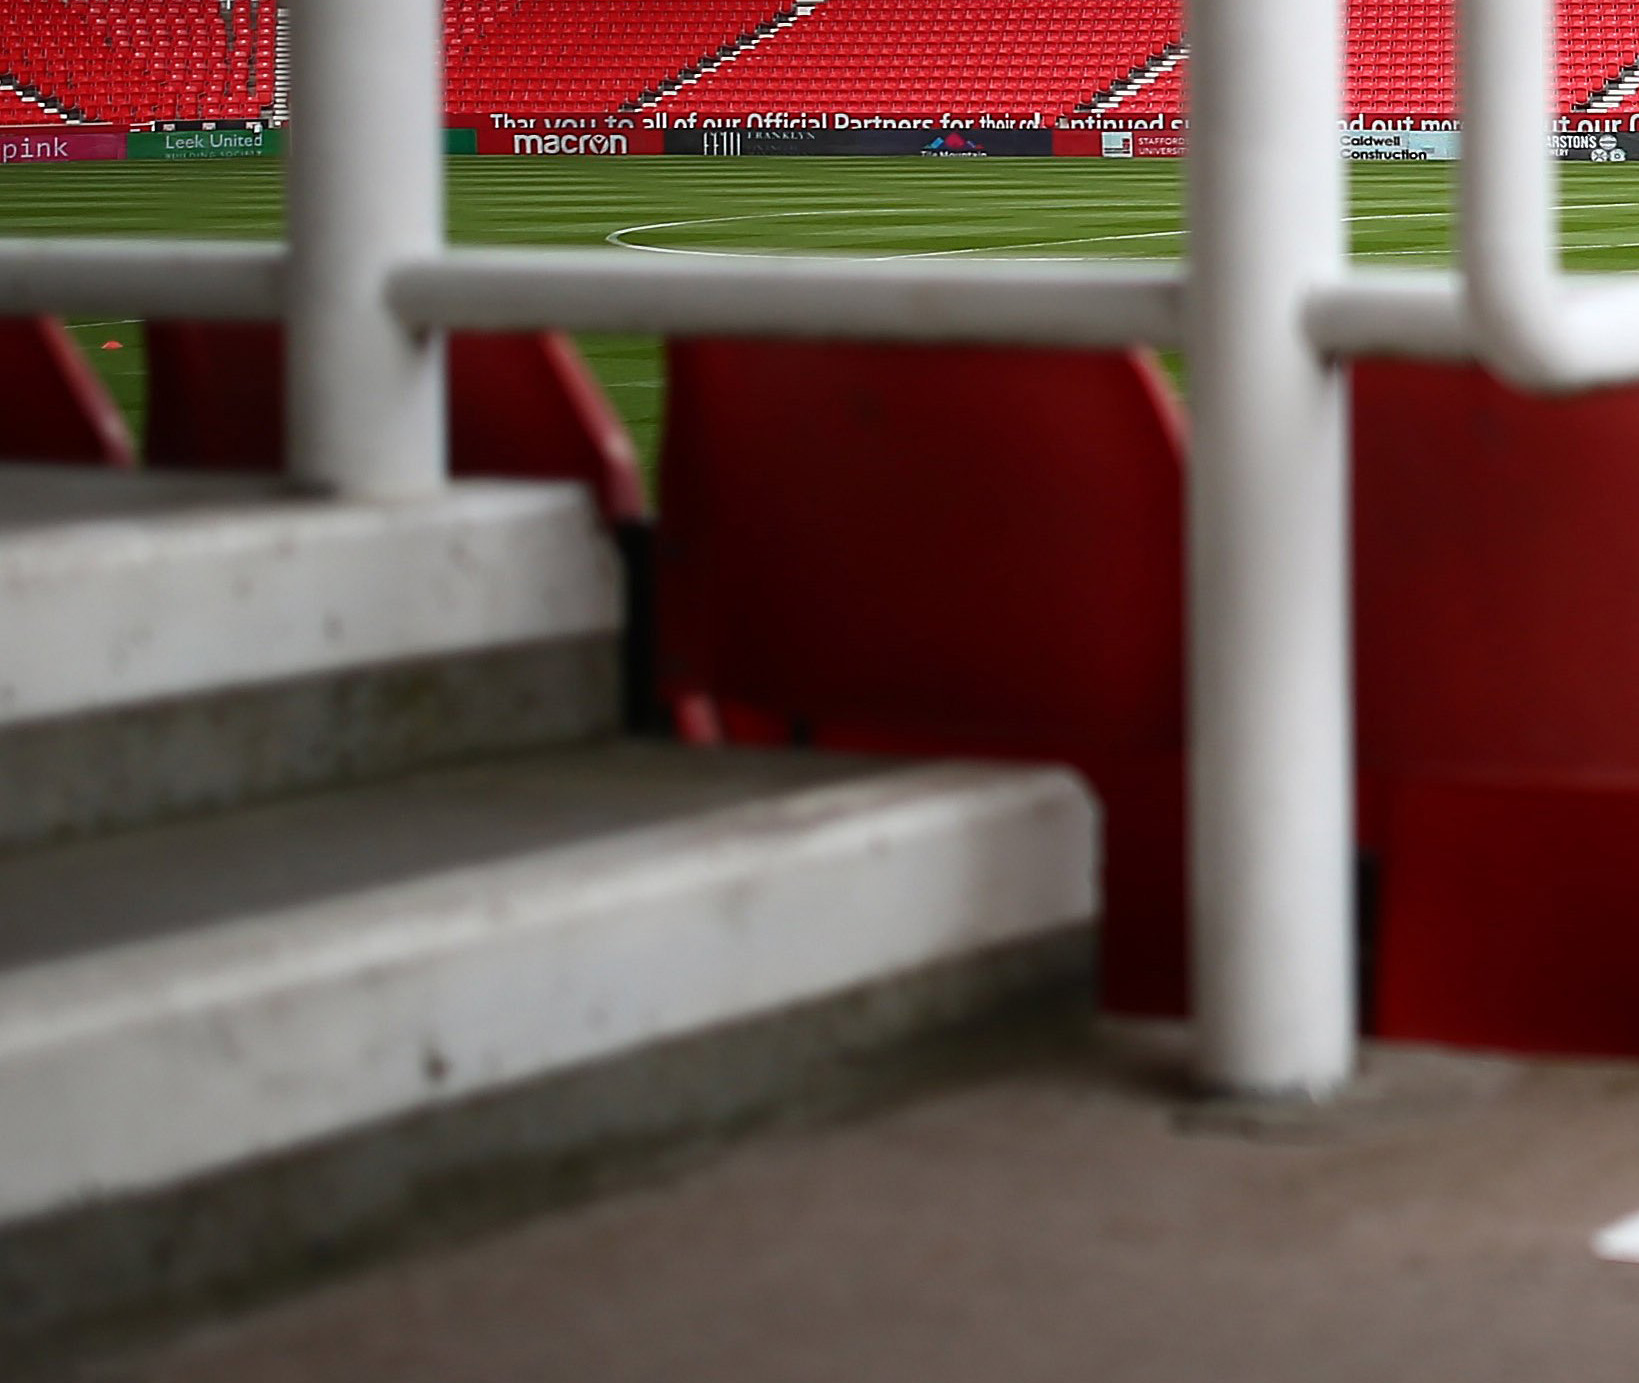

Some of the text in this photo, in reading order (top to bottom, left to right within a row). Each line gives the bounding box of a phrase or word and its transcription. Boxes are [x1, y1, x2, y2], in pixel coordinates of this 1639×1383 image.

[165, 133, 263, 149] Leek United
[514, 134, 628, 155] macron
[1138, 137, 1187, 146] STAFFORD
[1340, 135, 1401, 147] Caldwell
[1546, 134, 1597, 149] ARSTON'S
[2, 136, 69, 162] pink
[1340, 148, 1427, 160] Construction
